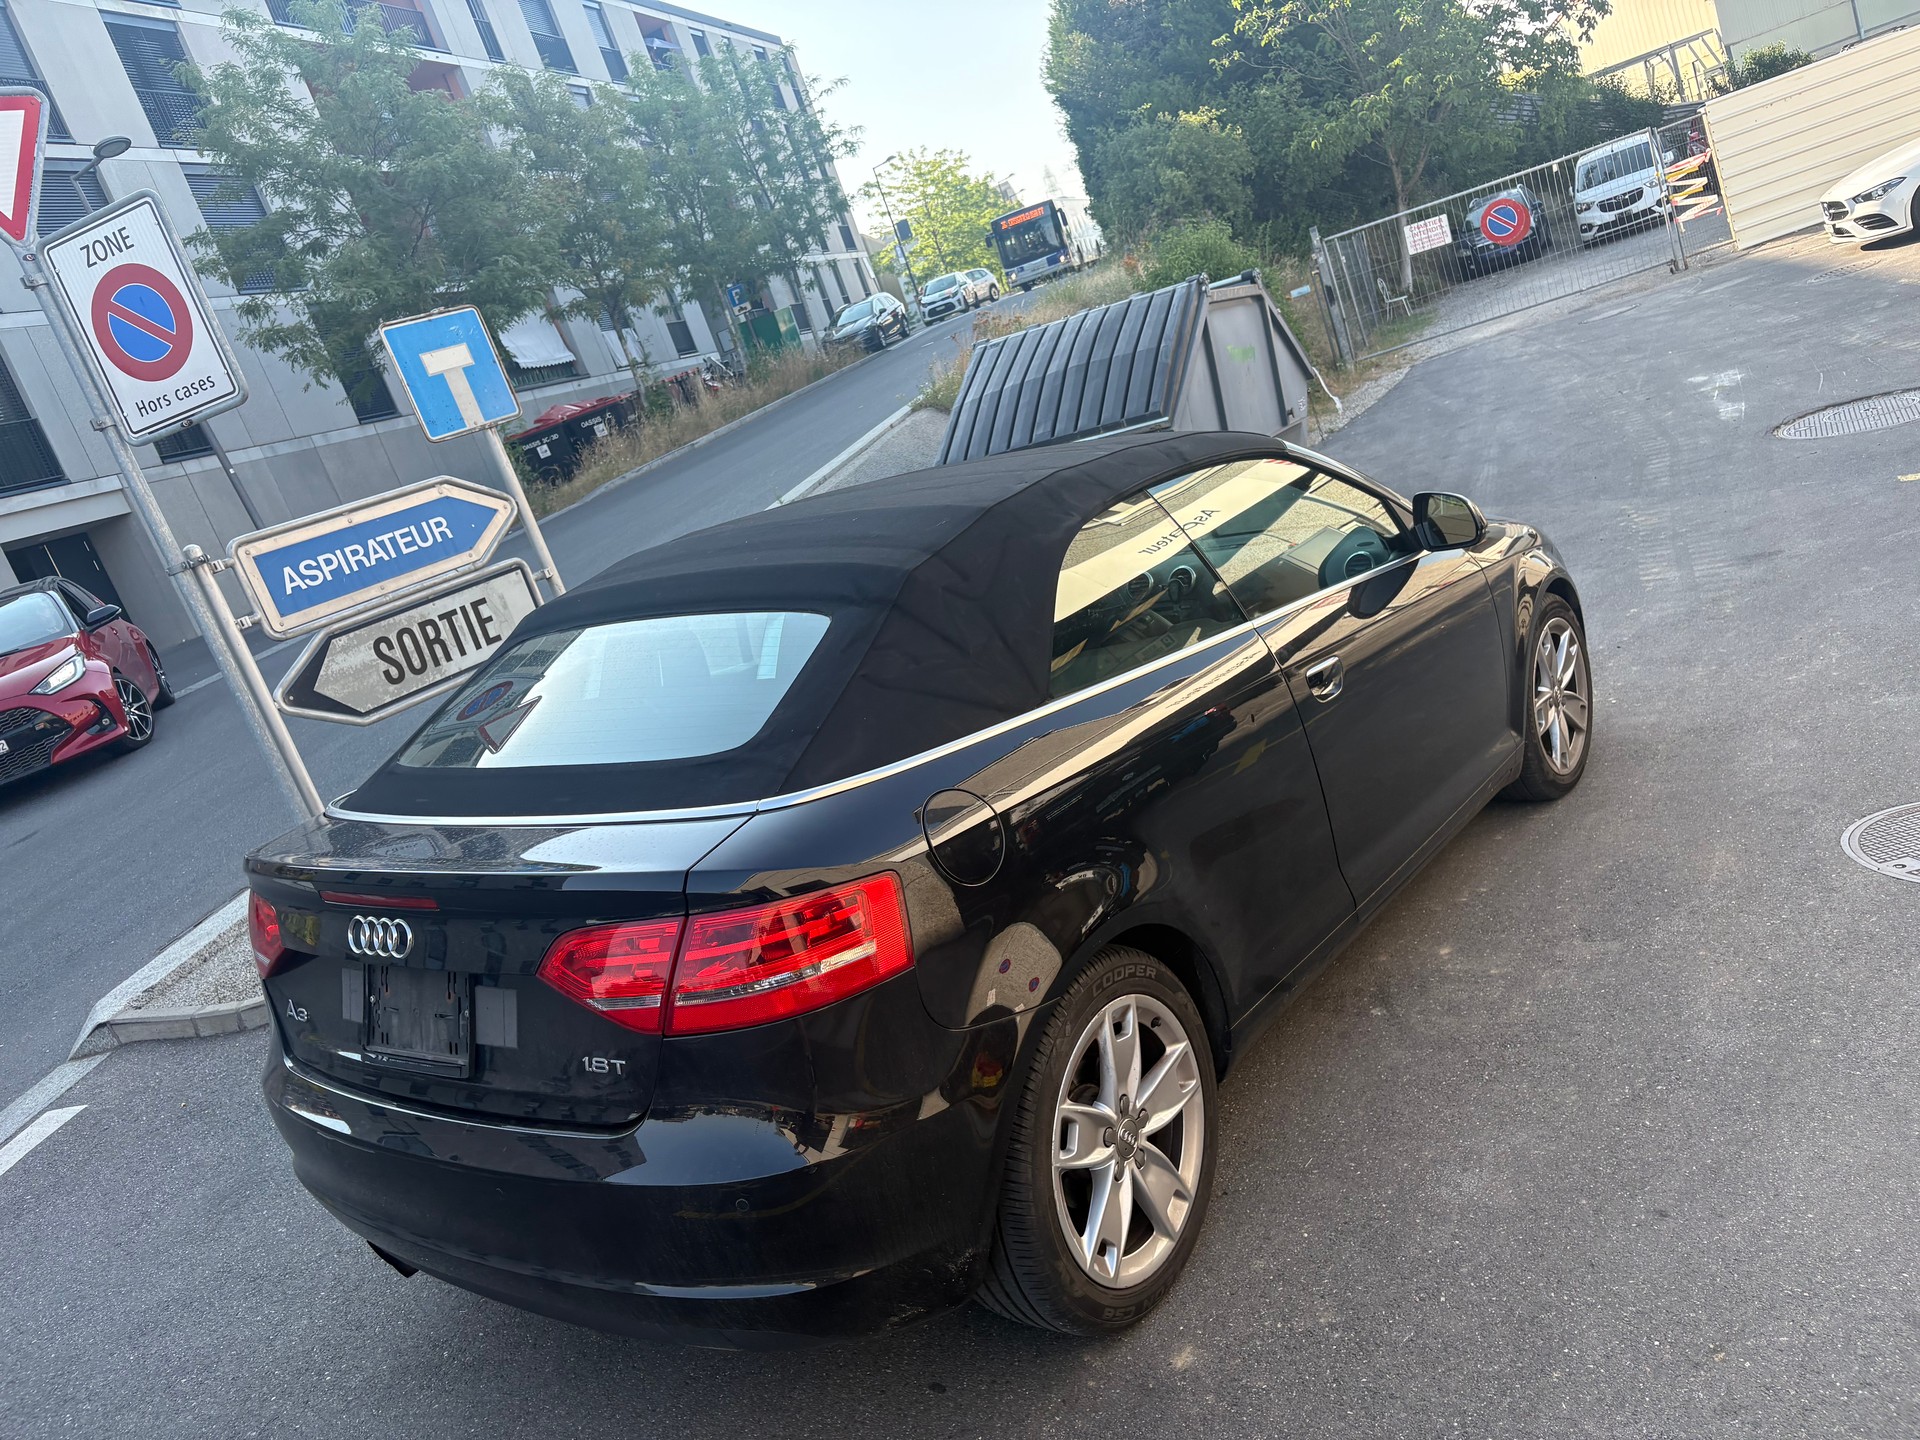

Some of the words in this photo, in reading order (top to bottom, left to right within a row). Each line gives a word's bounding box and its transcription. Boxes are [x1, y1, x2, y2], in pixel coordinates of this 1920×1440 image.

[80, 226, 135, 268] ZONE
[135, 393, 172, 417] Hors
[174, 375, 216, 401] cases
[283, 516, 453, 595] ASPIRATEUR
[372, 597, 502, 685] SORTIE
[1092, 964, 1157, 997] COOPER
[286, 998, 308, 1022] A3
